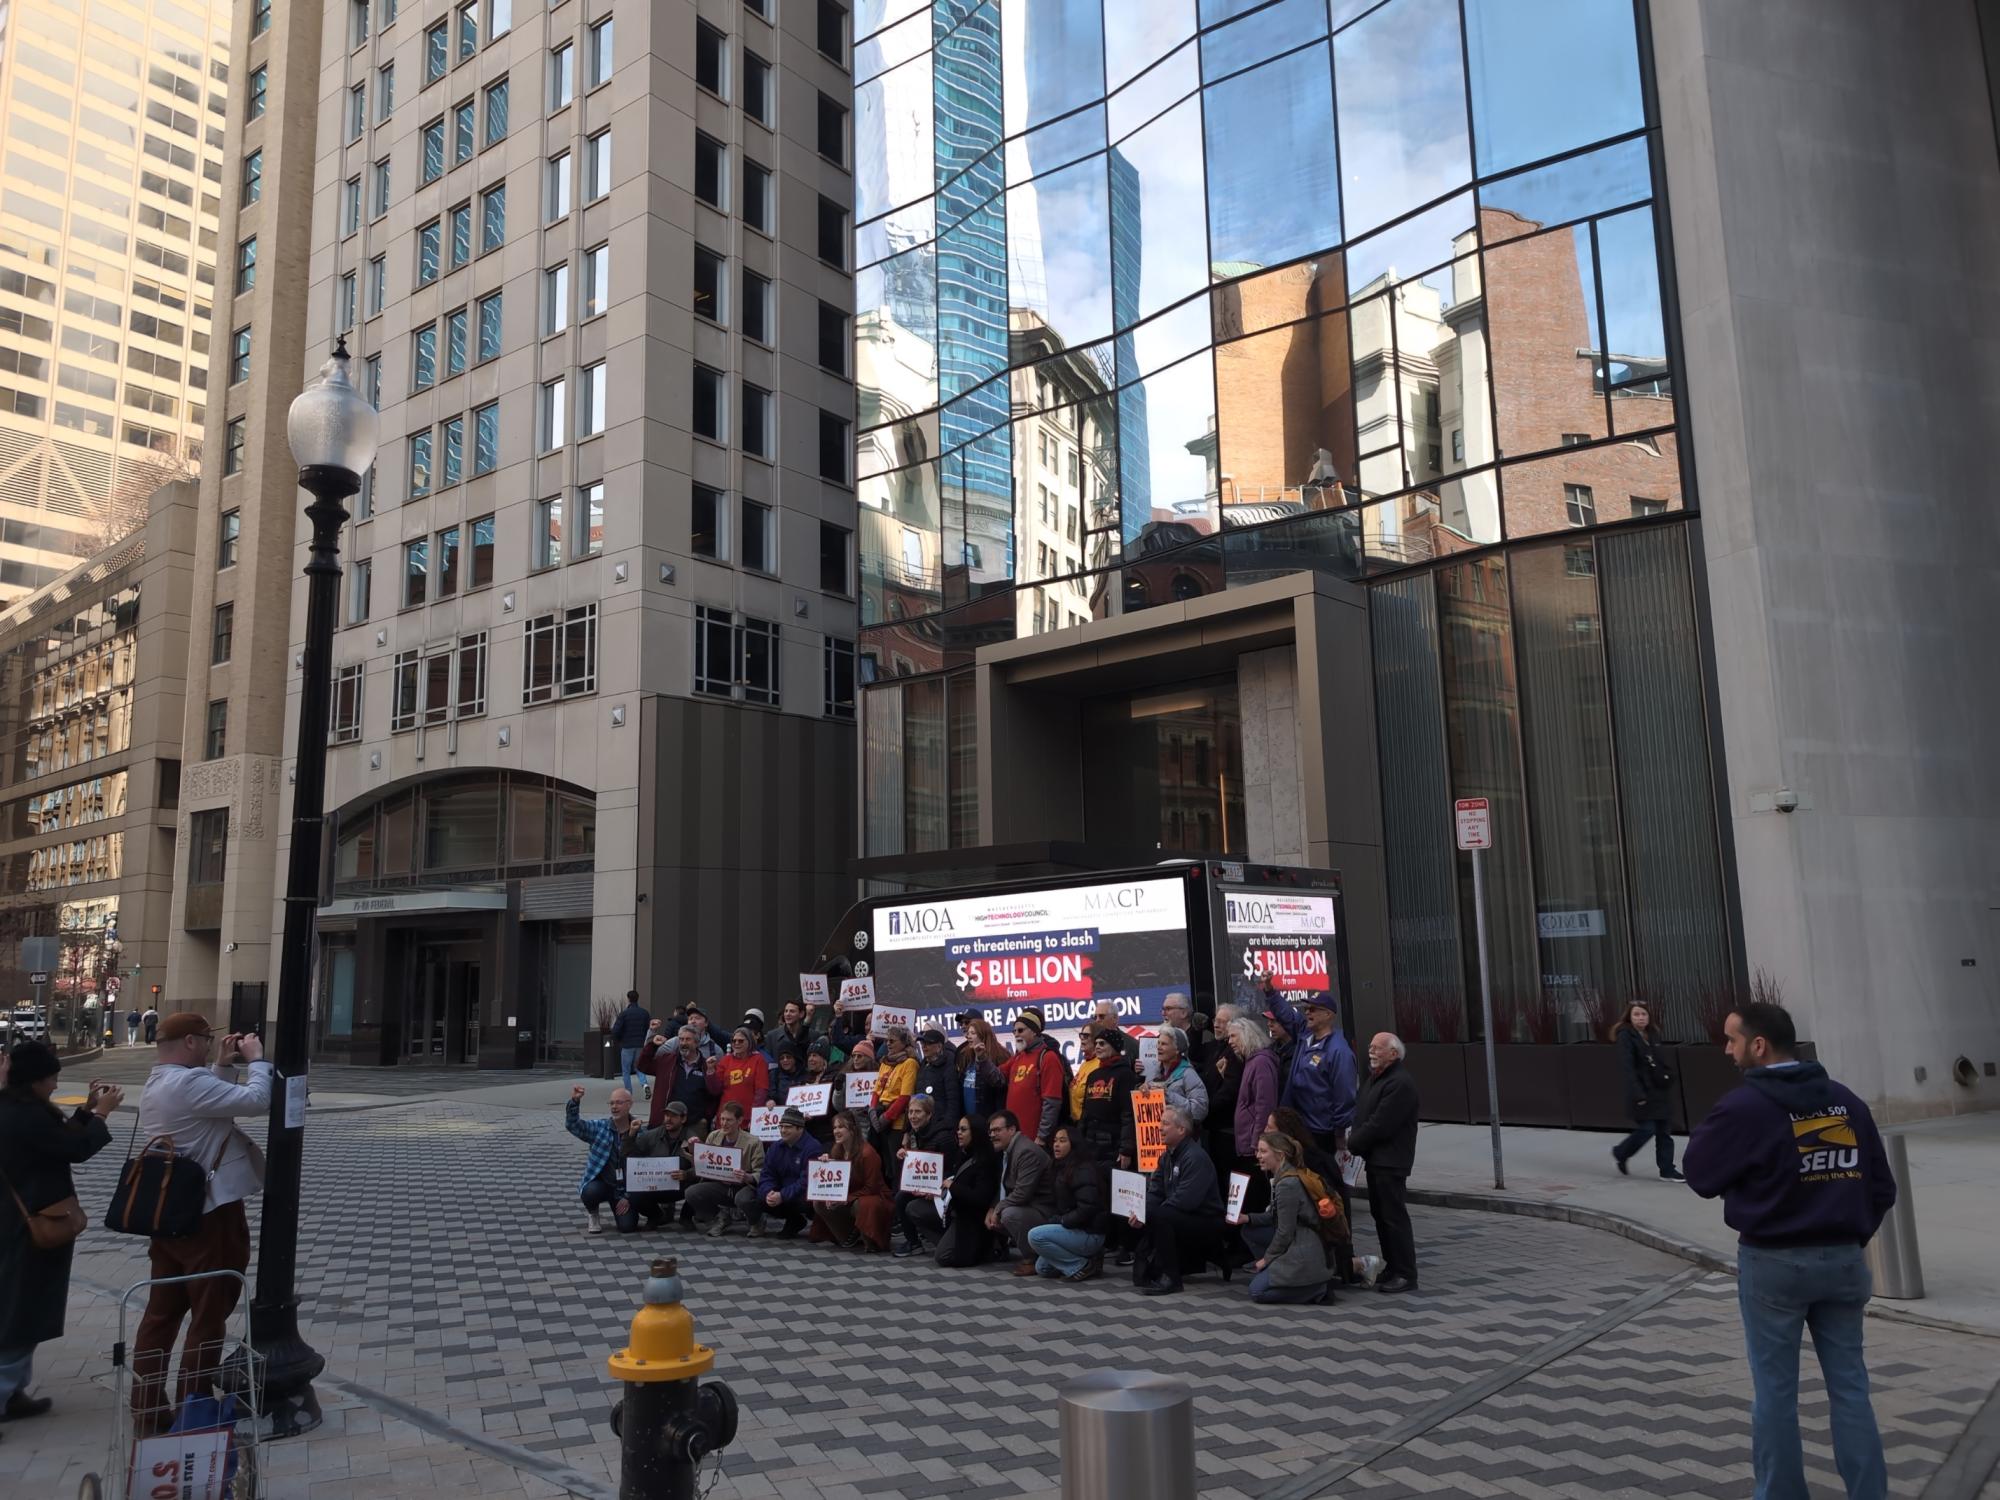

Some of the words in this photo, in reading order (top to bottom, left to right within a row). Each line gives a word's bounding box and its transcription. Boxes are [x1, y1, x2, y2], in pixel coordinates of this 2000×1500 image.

[1084, 888, 1144, 911] MACP
[1238, 902, 1274, 923] MOA
[903, 907, 955, 934] MOA
[1301, 915, 1326, 928] MACP
[951, 944, 971, 955] are
[973, 935, 1042, 952] threatening
[1045, 936, 1058, 948] to
[1061, 930, 1093, 947] slash
[1249, 938, 1260, 946] are
[1262, 935, 1298, 949] threatening
[1300, 936, 1307, 946] to
[1308, 935, 1323, 946] slash
[1243, 947, 1264, 980] $5
[1267, 951, 1327, 976] BILLION
[956, 959, 983, 991] $5
[989, 954, 1082, 986] BILLION
[1282, 975, 1297, 985] from
[848, 984, 867, 997] S.O.S
[1007, 987, 1028, 998] from
[1280, 990, 1308, 1002] CATION
[884, 1013, 907, 1025] S.O.S
[915, 1008, 1002, 1033] HEALTHRE
[1044, 996, 1141, 1022] EDUCAON
[800, 1091, 822, 1103] S.O.S
[1828, 1105, 1847, 1116] 509
[1140, 1125, 1161, 1146] LABO
[708, 1152, 732, 1166] S.O.S
[1799, 1148, 1859, 1173] SEIU
[915, 1160, 937, 1173] S.O.S
[820, 1169, 842, 1182] S.O.S
[184, 1452, 196, 1482] STATE
